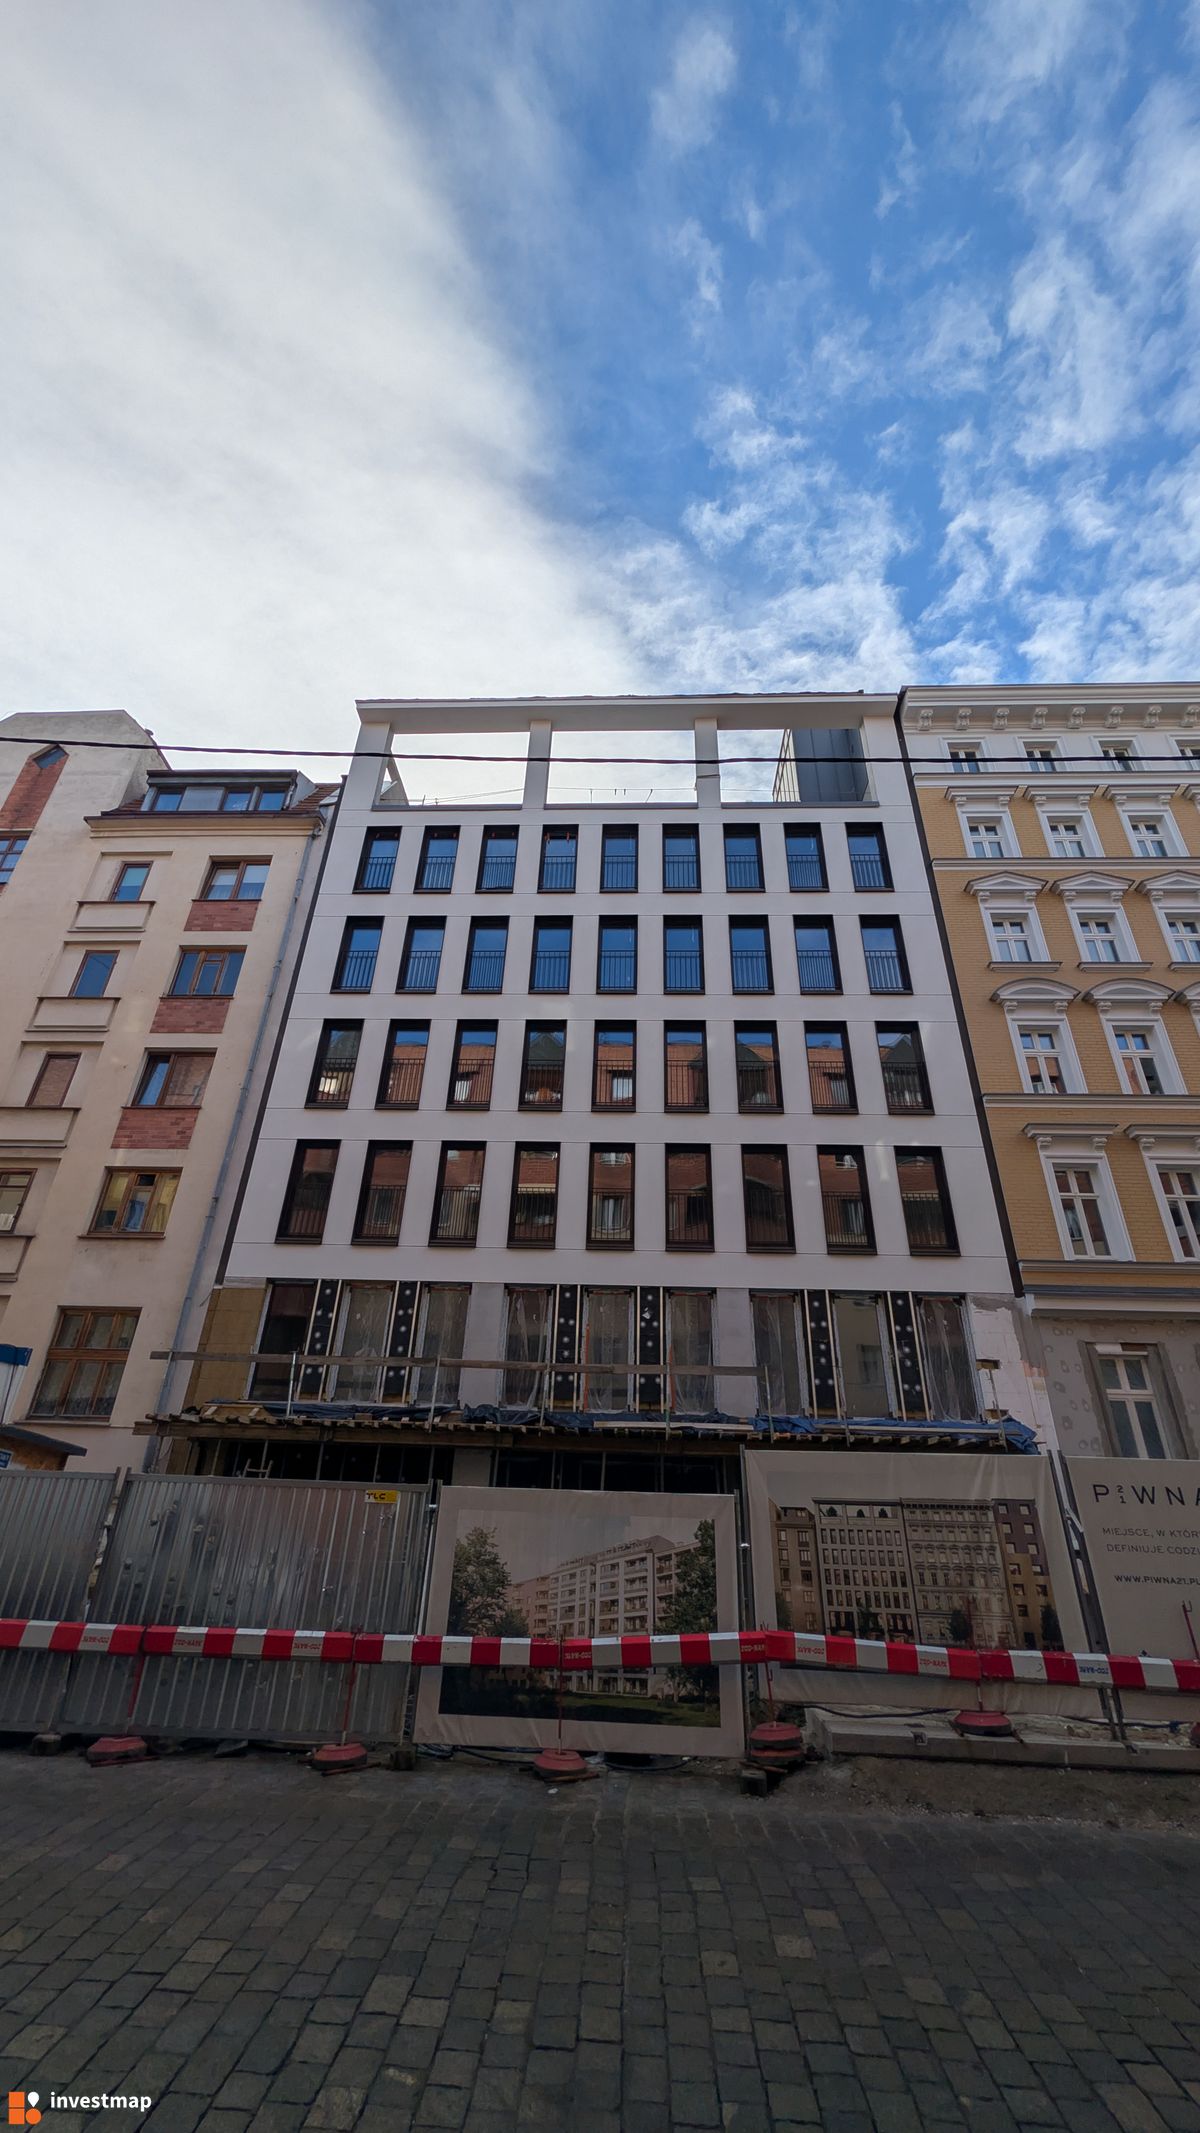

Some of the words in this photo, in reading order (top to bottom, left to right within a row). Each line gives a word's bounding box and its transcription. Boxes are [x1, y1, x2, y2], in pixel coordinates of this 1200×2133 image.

[1102, 1527, 1154, 1539] MIEJSCE,
[1156, 1529, 1166, 1538] W
[1168, 1528, 1200, 1539] KTÓR
[1106, 1543, 1165, 1554] DEFINIUJE
